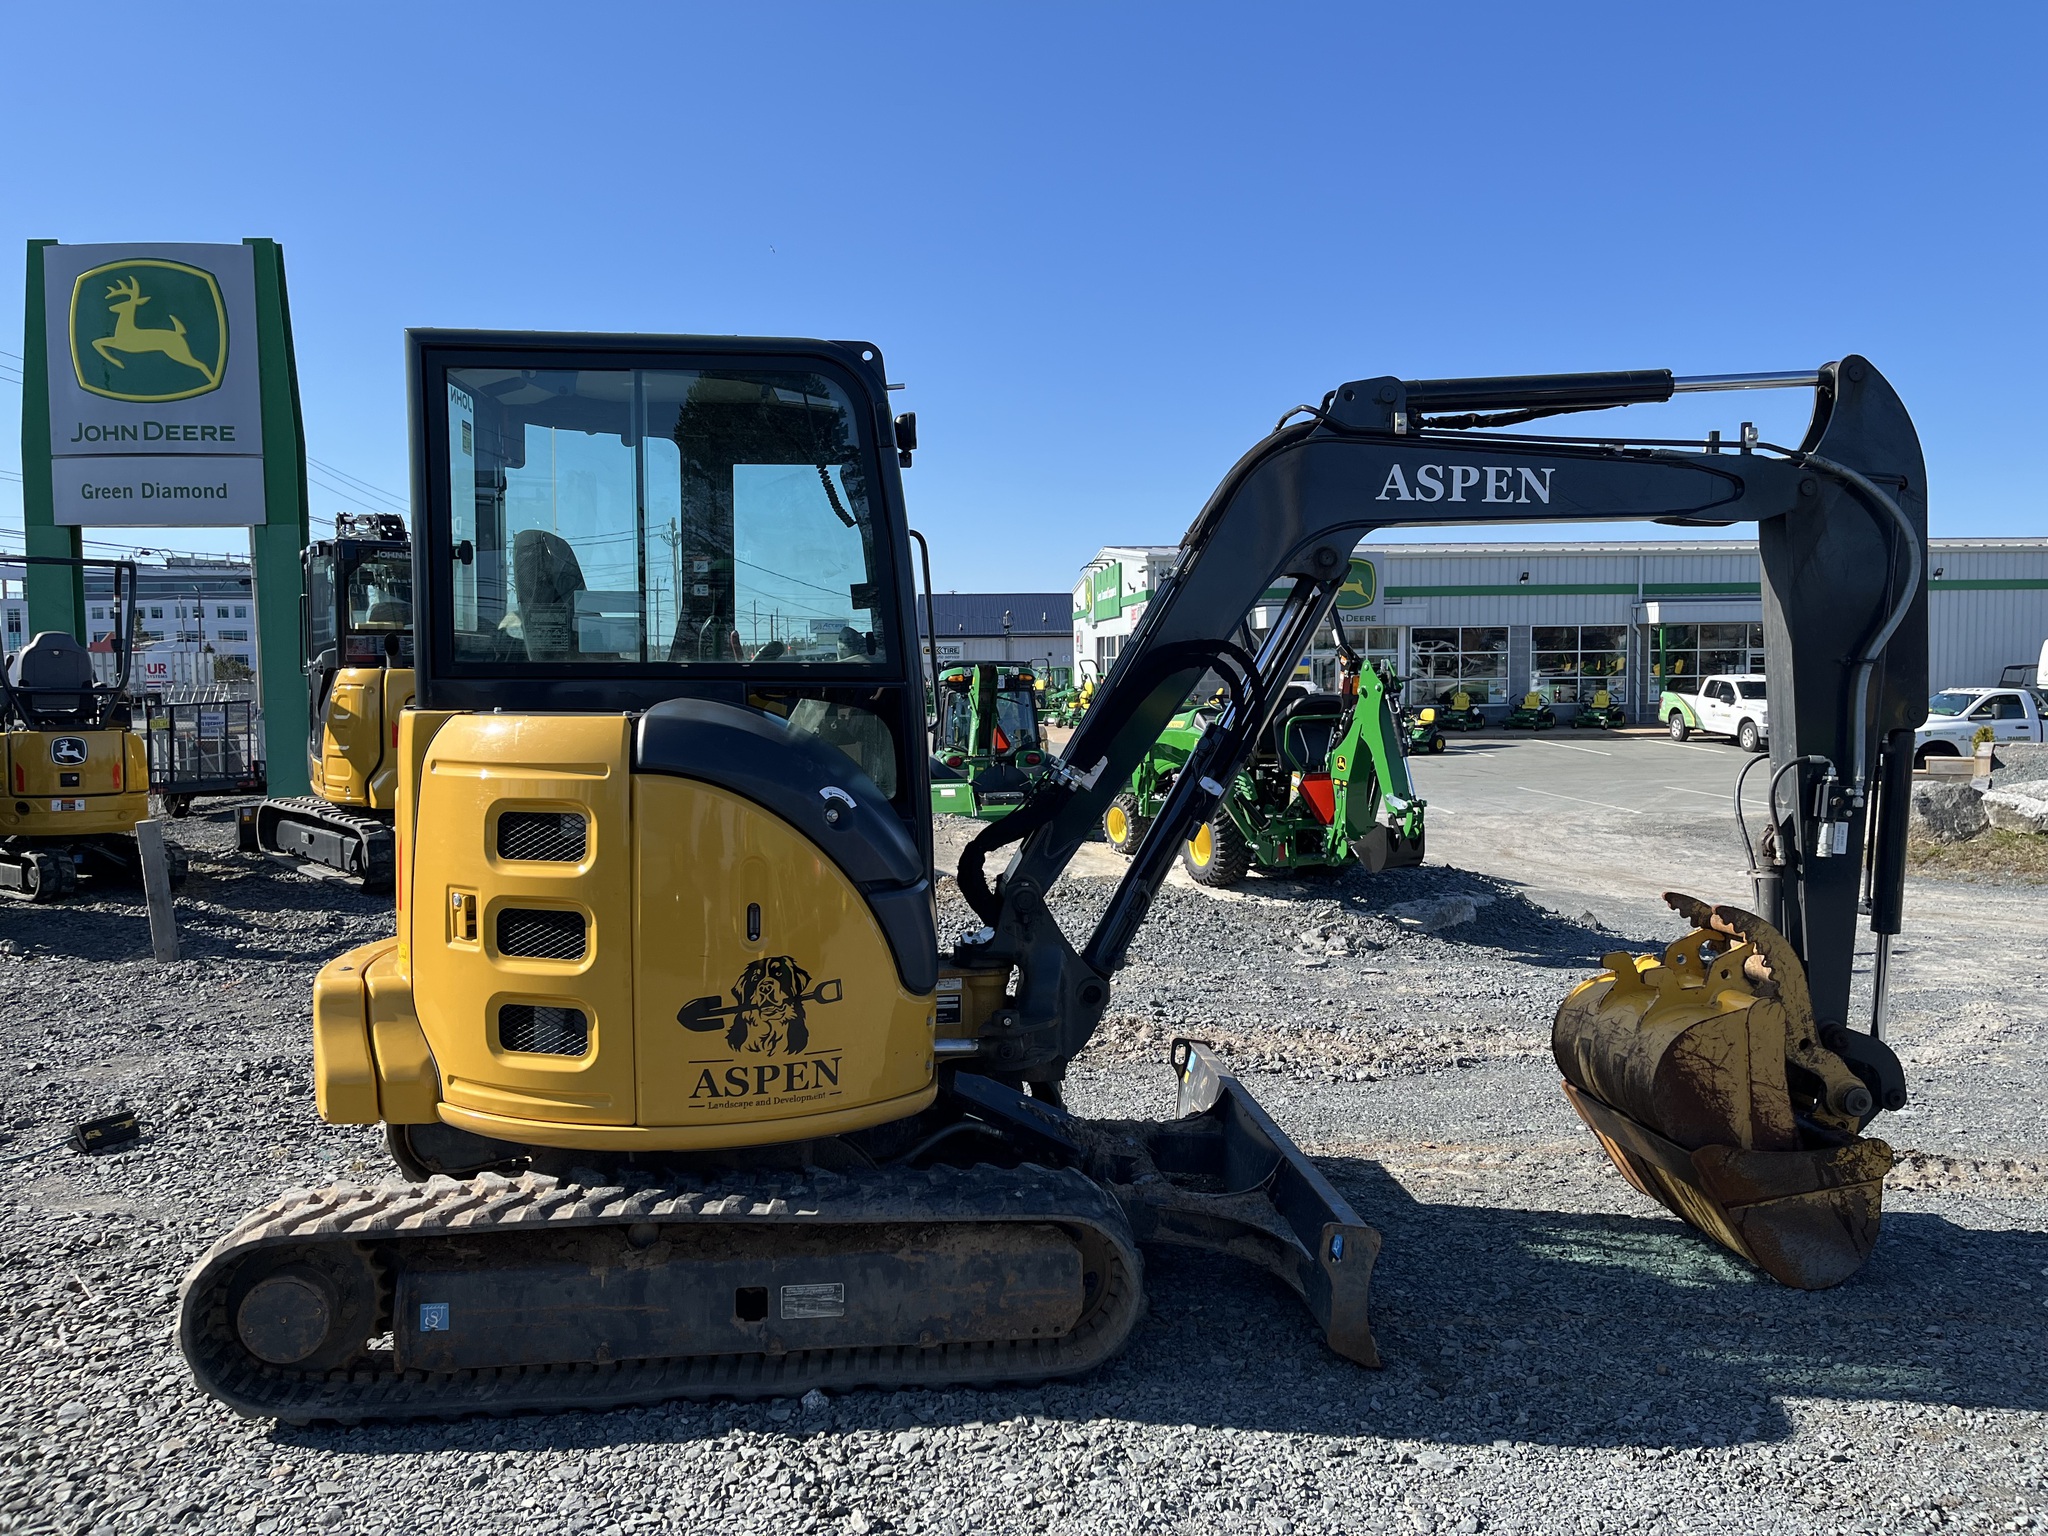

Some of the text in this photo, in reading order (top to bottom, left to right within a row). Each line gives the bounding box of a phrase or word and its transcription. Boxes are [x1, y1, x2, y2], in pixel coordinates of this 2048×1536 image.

[70, 421, 236, 443] JOHN DEERE
[81, 482, 228, 500] Green Diamond
[1375, 463, 1556, 504] ASPEN
[374, 550, 403, 560] JOHN
[1346, 614, 1377, 622] DEERE
[688, 1056, 843, 1099] ASPEN
[708, 1092, 826, 1110] Landscape and Development
